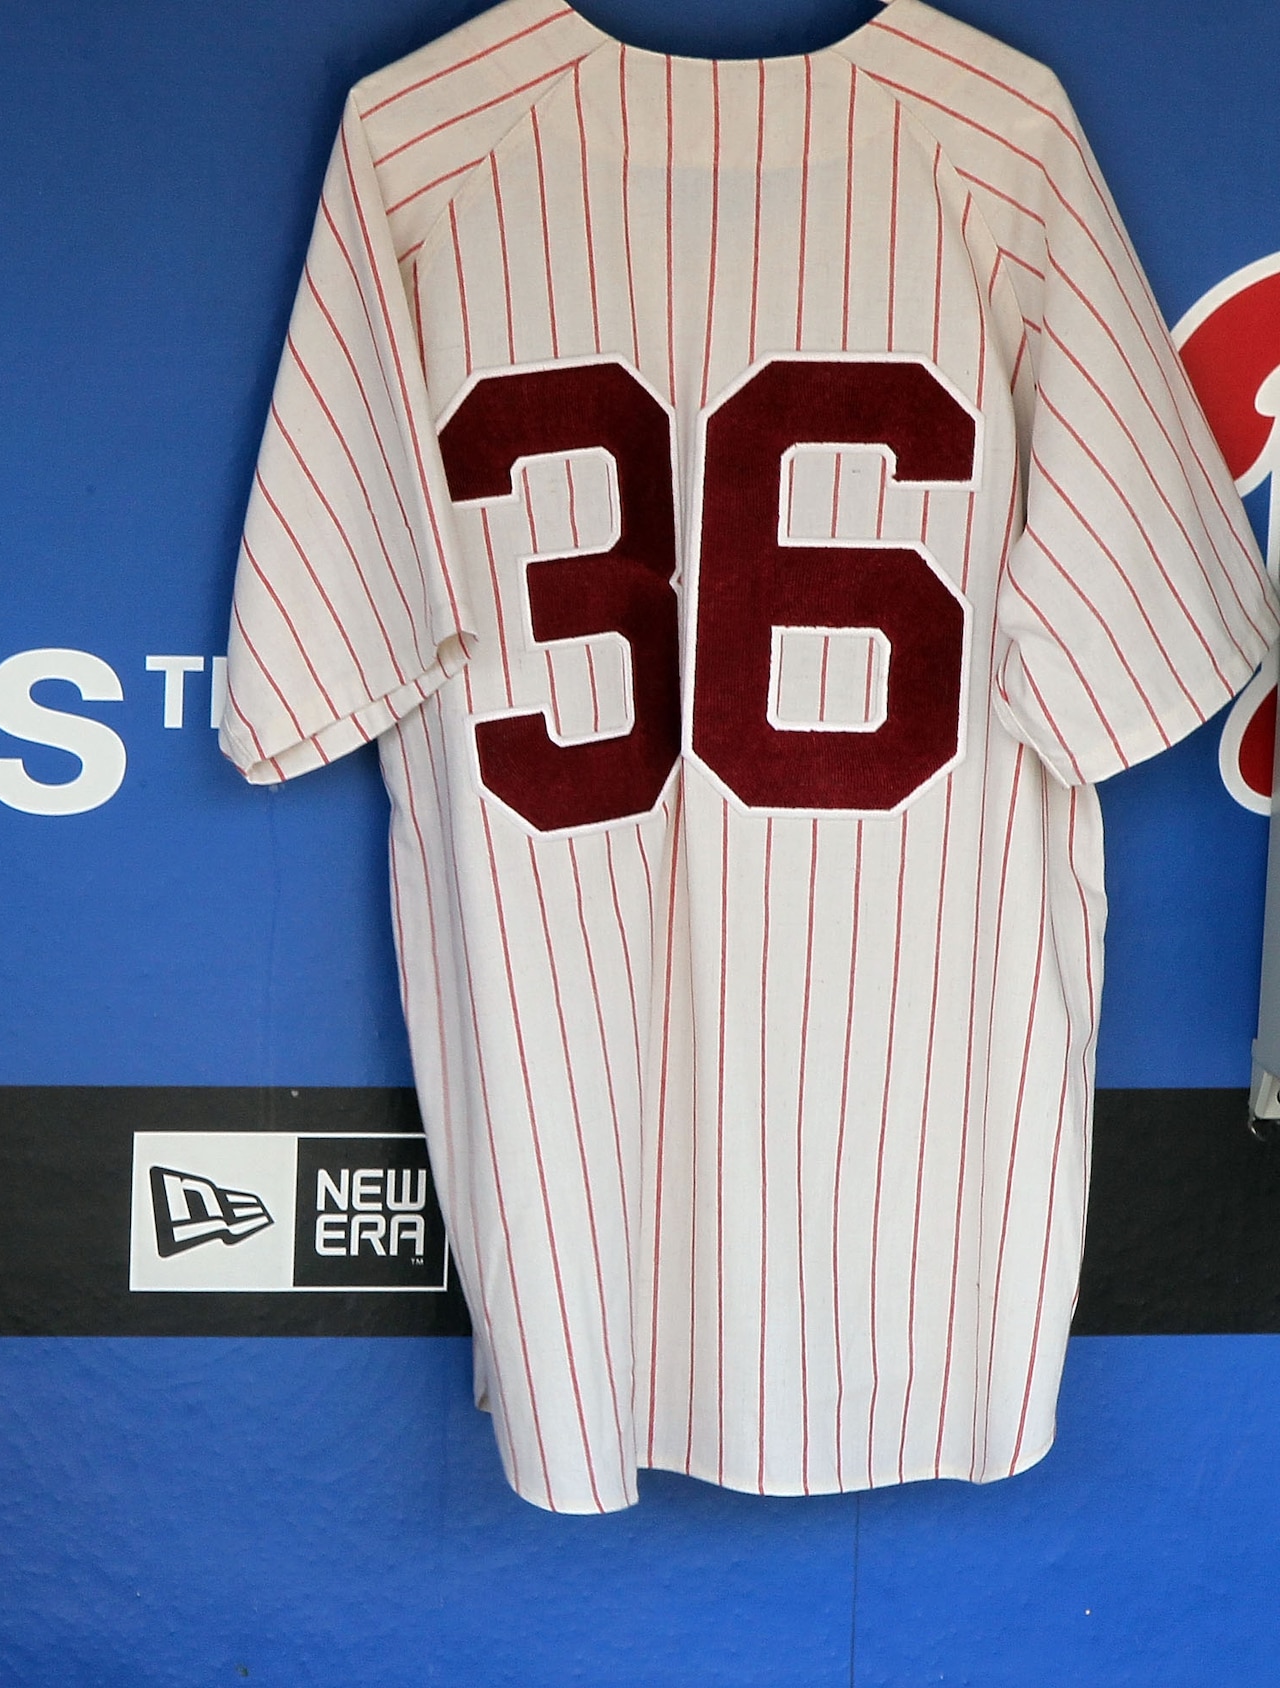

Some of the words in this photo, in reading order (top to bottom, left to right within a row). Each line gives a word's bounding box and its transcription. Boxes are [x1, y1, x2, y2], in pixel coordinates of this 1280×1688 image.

[435, 351, 985, 842] 36
[316, 1168, 427, 1211] NEW
[315, 1214, 425, 1256] ERA
